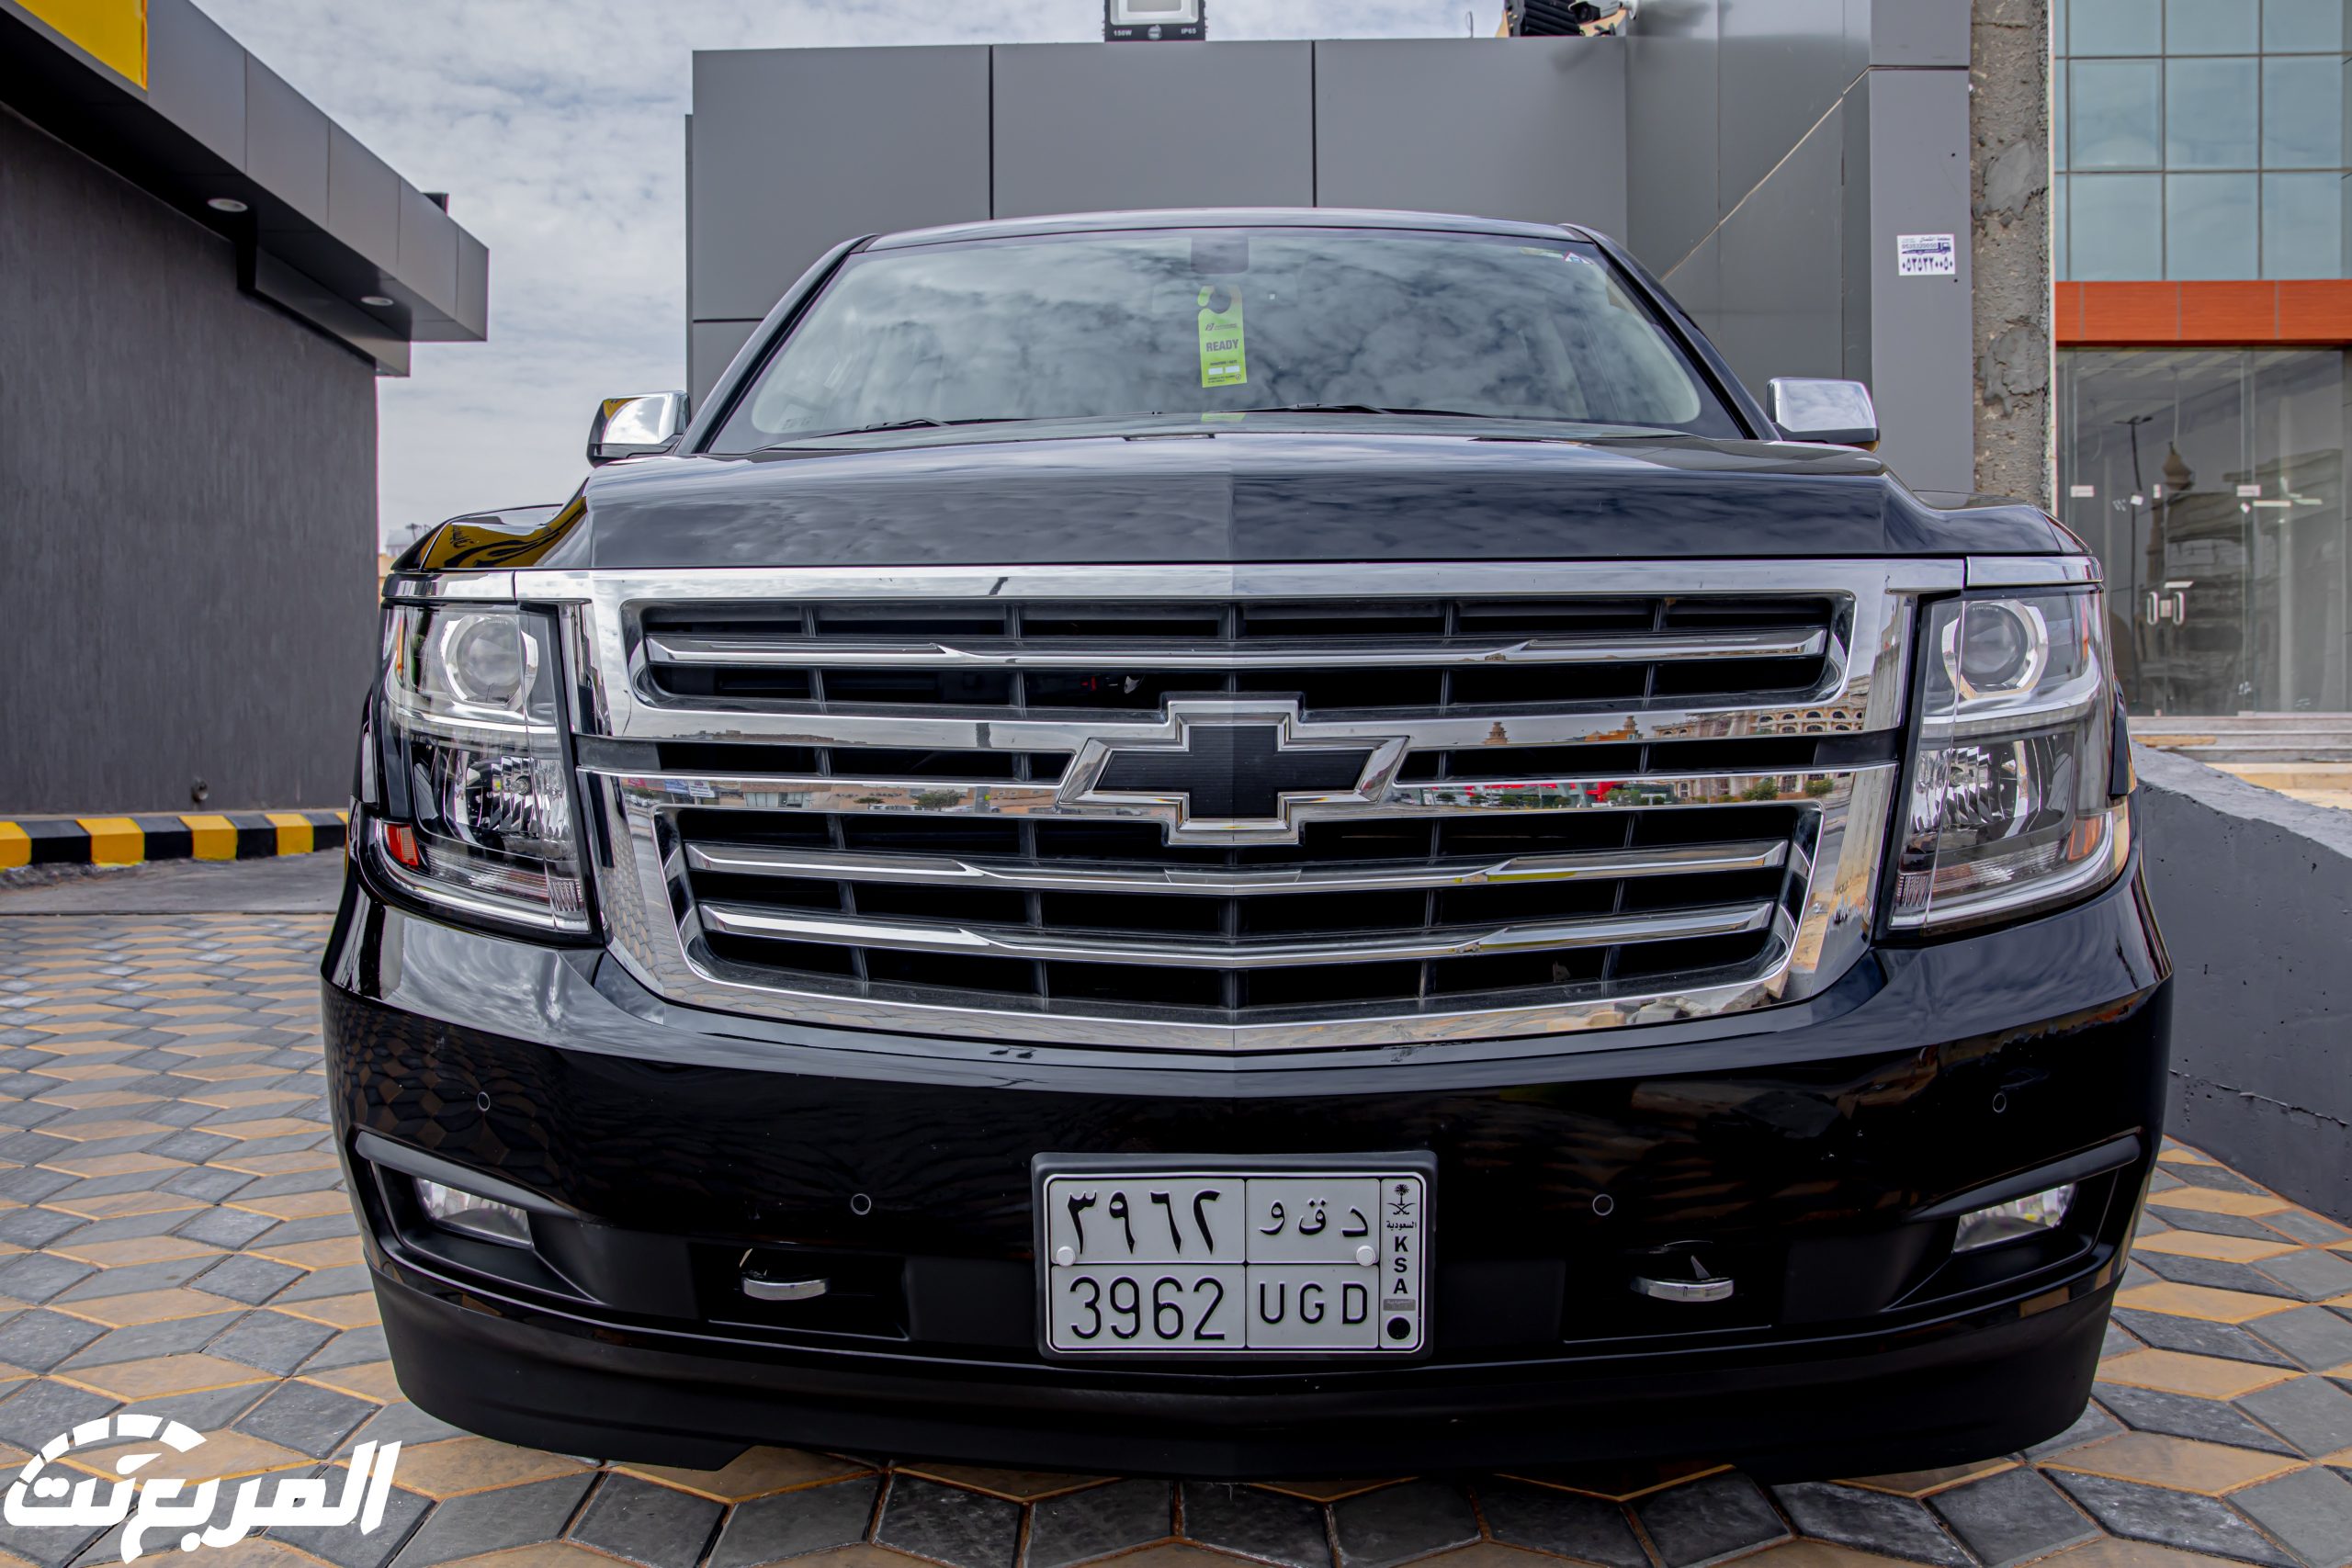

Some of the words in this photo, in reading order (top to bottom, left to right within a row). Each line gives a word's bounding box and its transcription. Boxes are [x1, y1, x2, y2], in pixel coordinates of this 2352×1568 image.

[1205, 338, 1239, 353] READY
[1067, 1190, 1222, 1256] ٣٩٦٢
[1385, 1220, 1418, 1232] السعودية
[1393, 1235, 1409, 1294] KSA
[1069, 1275, 1227, 1341] 3962
[1259, 1281, 1369, 1325] UGD
